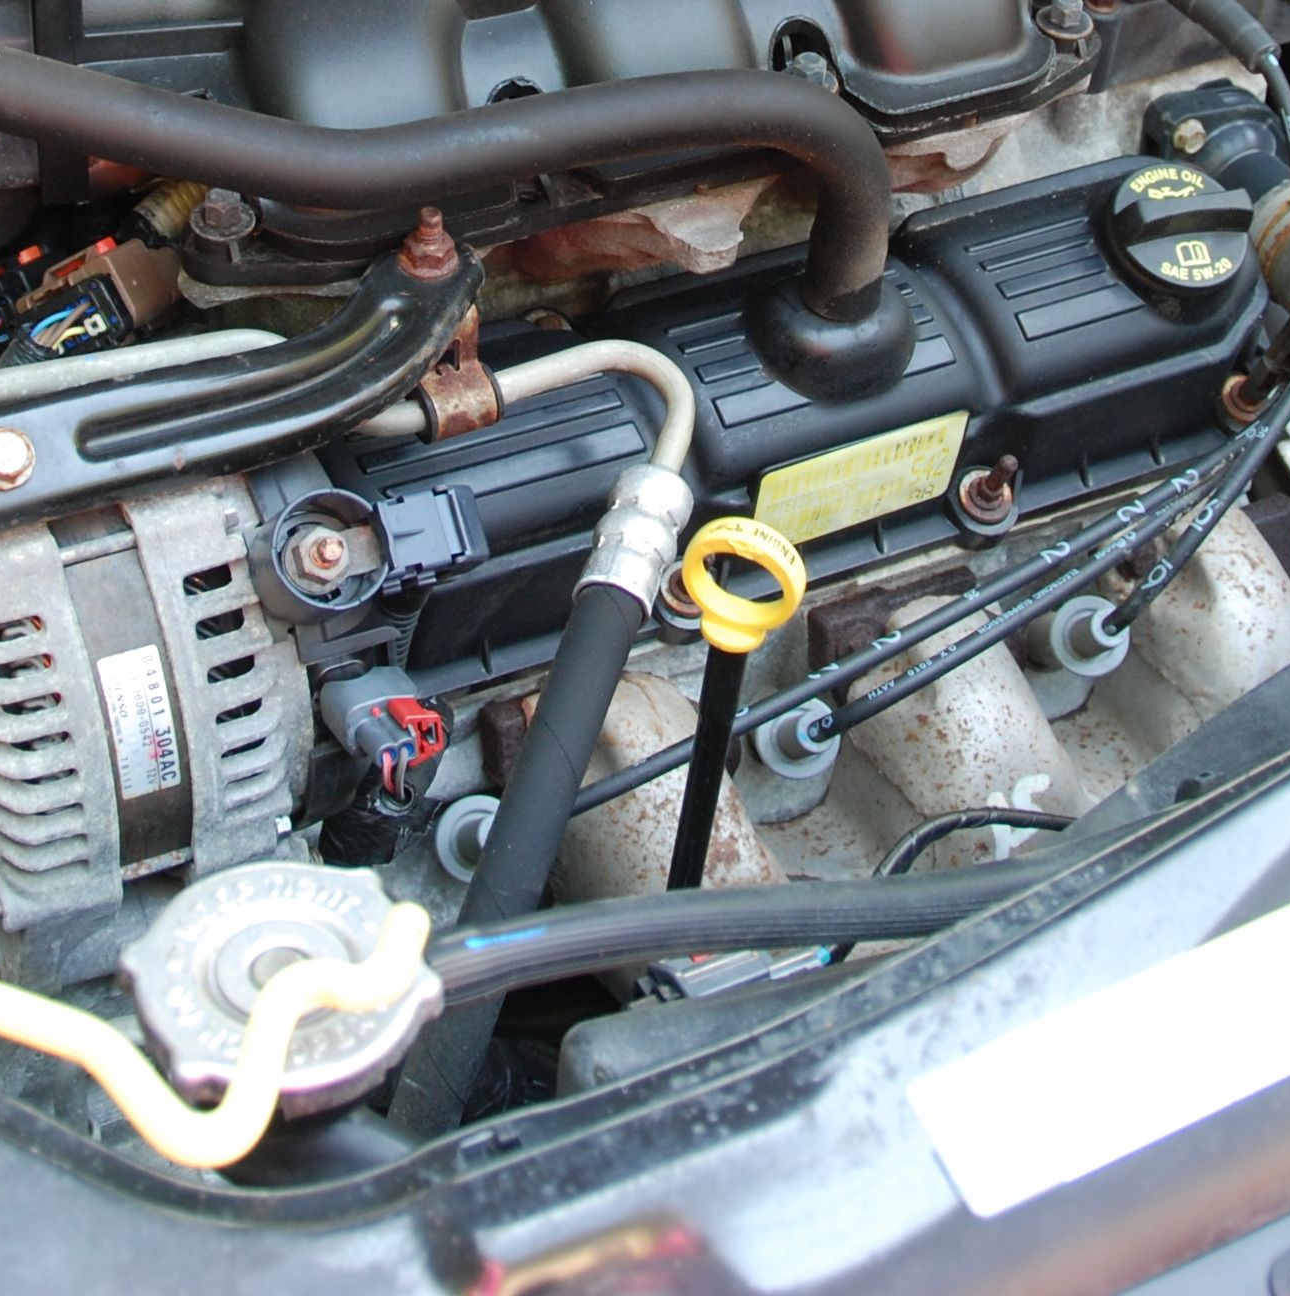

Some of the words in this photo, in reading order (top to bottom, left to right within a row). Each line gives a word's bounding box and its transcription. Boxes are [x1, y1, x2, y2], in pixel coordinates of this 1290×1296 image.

[1129, 168, 1179, 193] ENGINE
[1181, 170, 1205, 189] OIL
[1160, 261, 1189, 281] SAE
[1192, 257, 1233, 281] 5W-20
[753, 527, 795, 565] ENGINE
[1032, 567, 1081, 600] ELECTRONIC
[978, 596, 1034, 635] SUPPRESSION
[155, 725, 177, 782] 304AC
